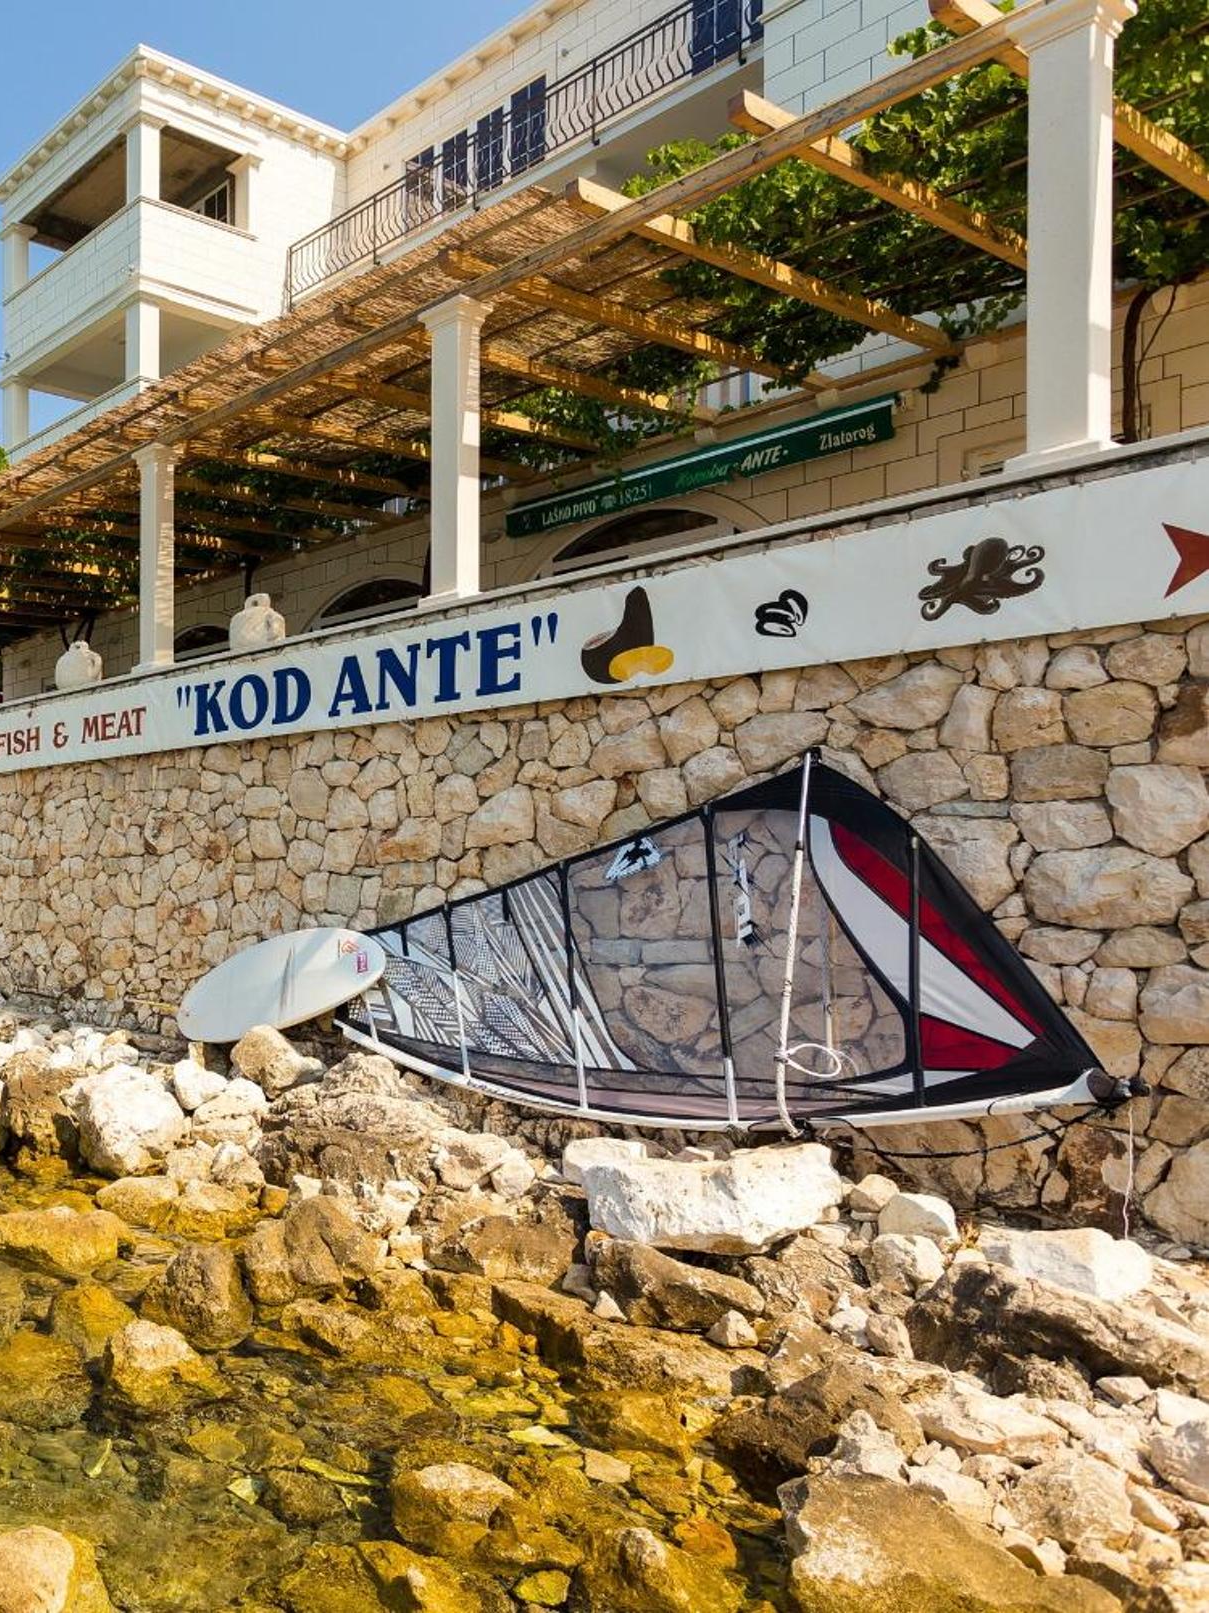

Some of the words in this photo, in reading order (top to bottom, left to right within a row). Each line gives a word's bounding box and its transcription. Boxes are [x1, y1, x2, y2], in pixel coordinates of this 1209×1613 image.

[572, 500, 596, 518] PIVO
[819, 424, 877, 451] Zlatorog
[52, 721, 69, 749] &
[80, 706, 147, 744] MEAT
